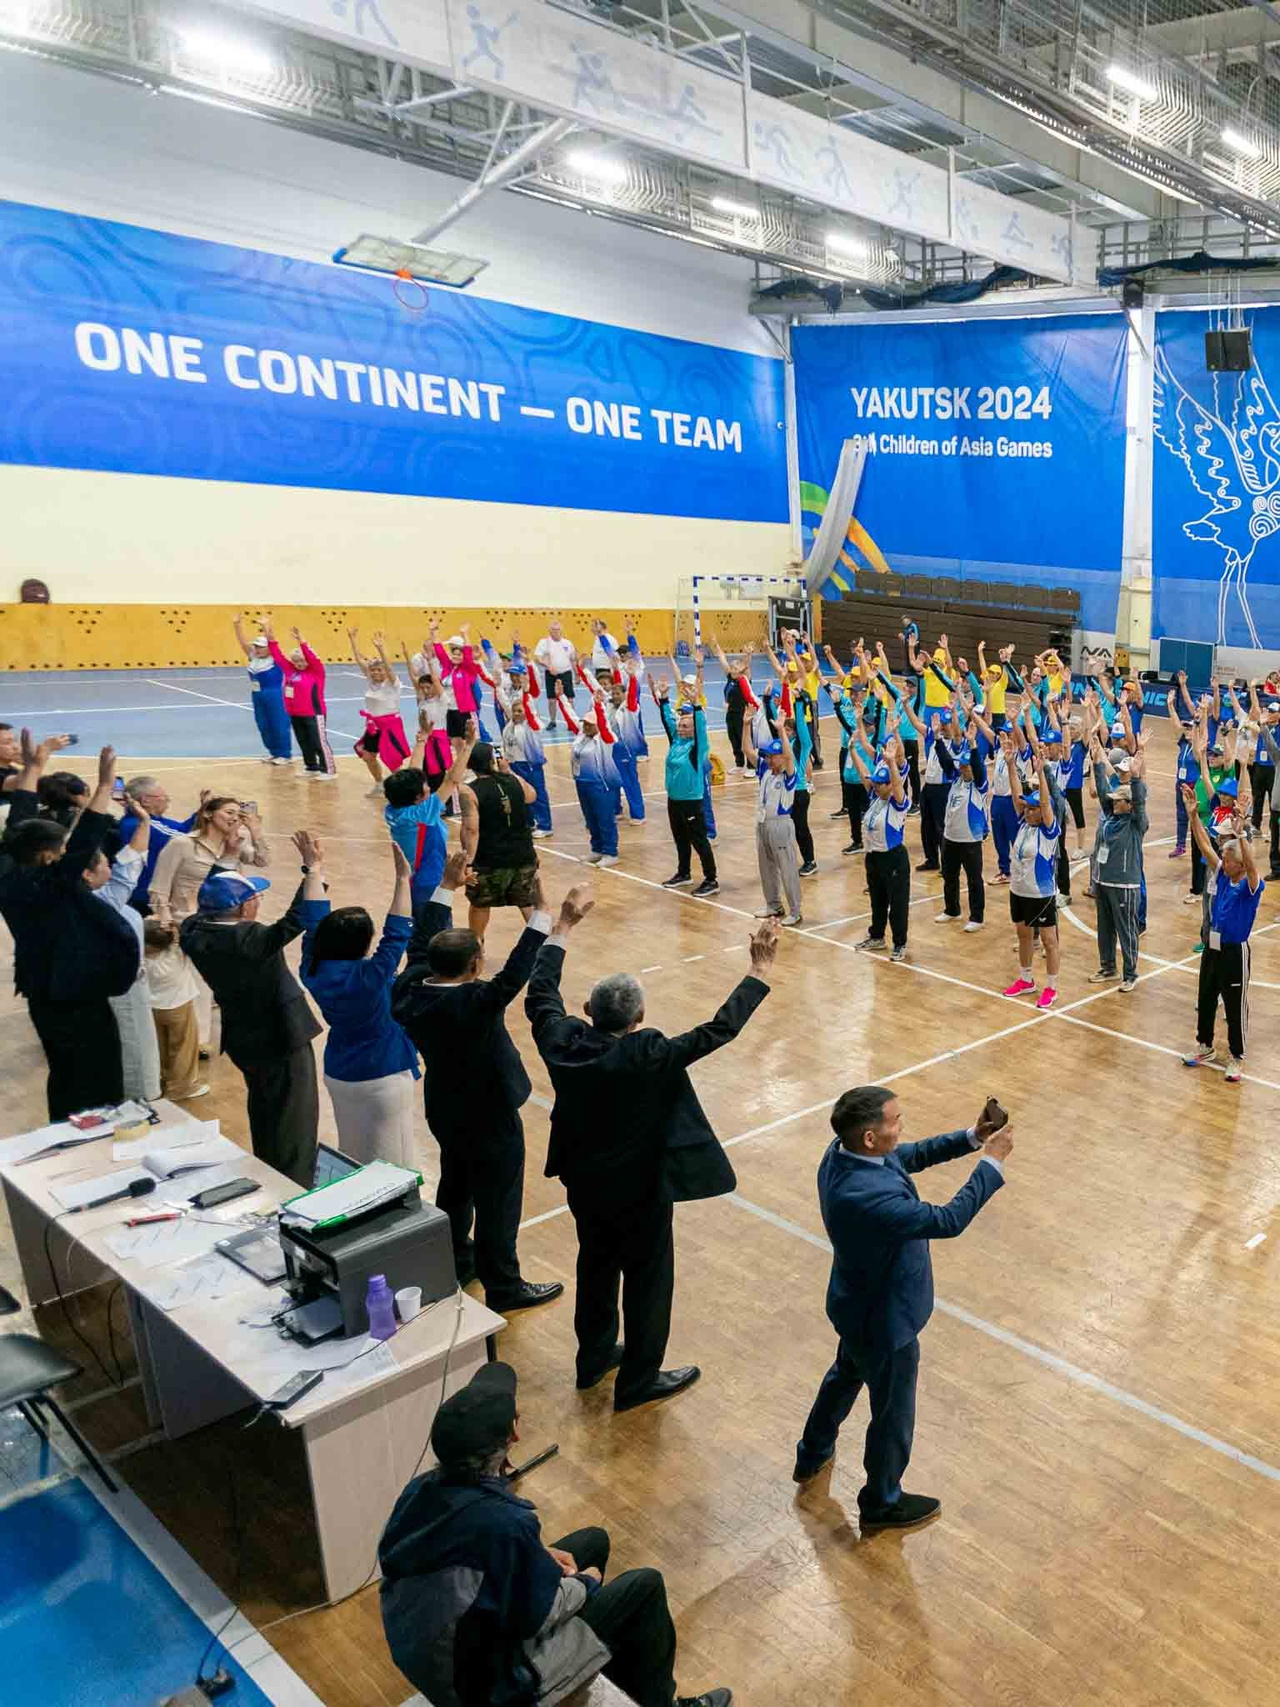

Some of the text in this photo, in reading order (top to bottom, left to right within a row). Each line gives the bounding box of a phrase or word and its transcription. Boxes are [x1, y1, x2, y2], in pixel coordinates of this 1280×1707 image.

[74, 321, 208, 384] ONE
[223, 344, 505, 422] CONTINENT
[566, 396, 642, 441] ONE
[651, 409, 742, 453] TEAM
[851, 386, 1052, 420] YAKUTSK 2024
[880, 434, 939, 455] Children
[942, 436, 958, 456] of
[960, 436, 993, 457] Asia
[997, 437, 1053, 458] Games
